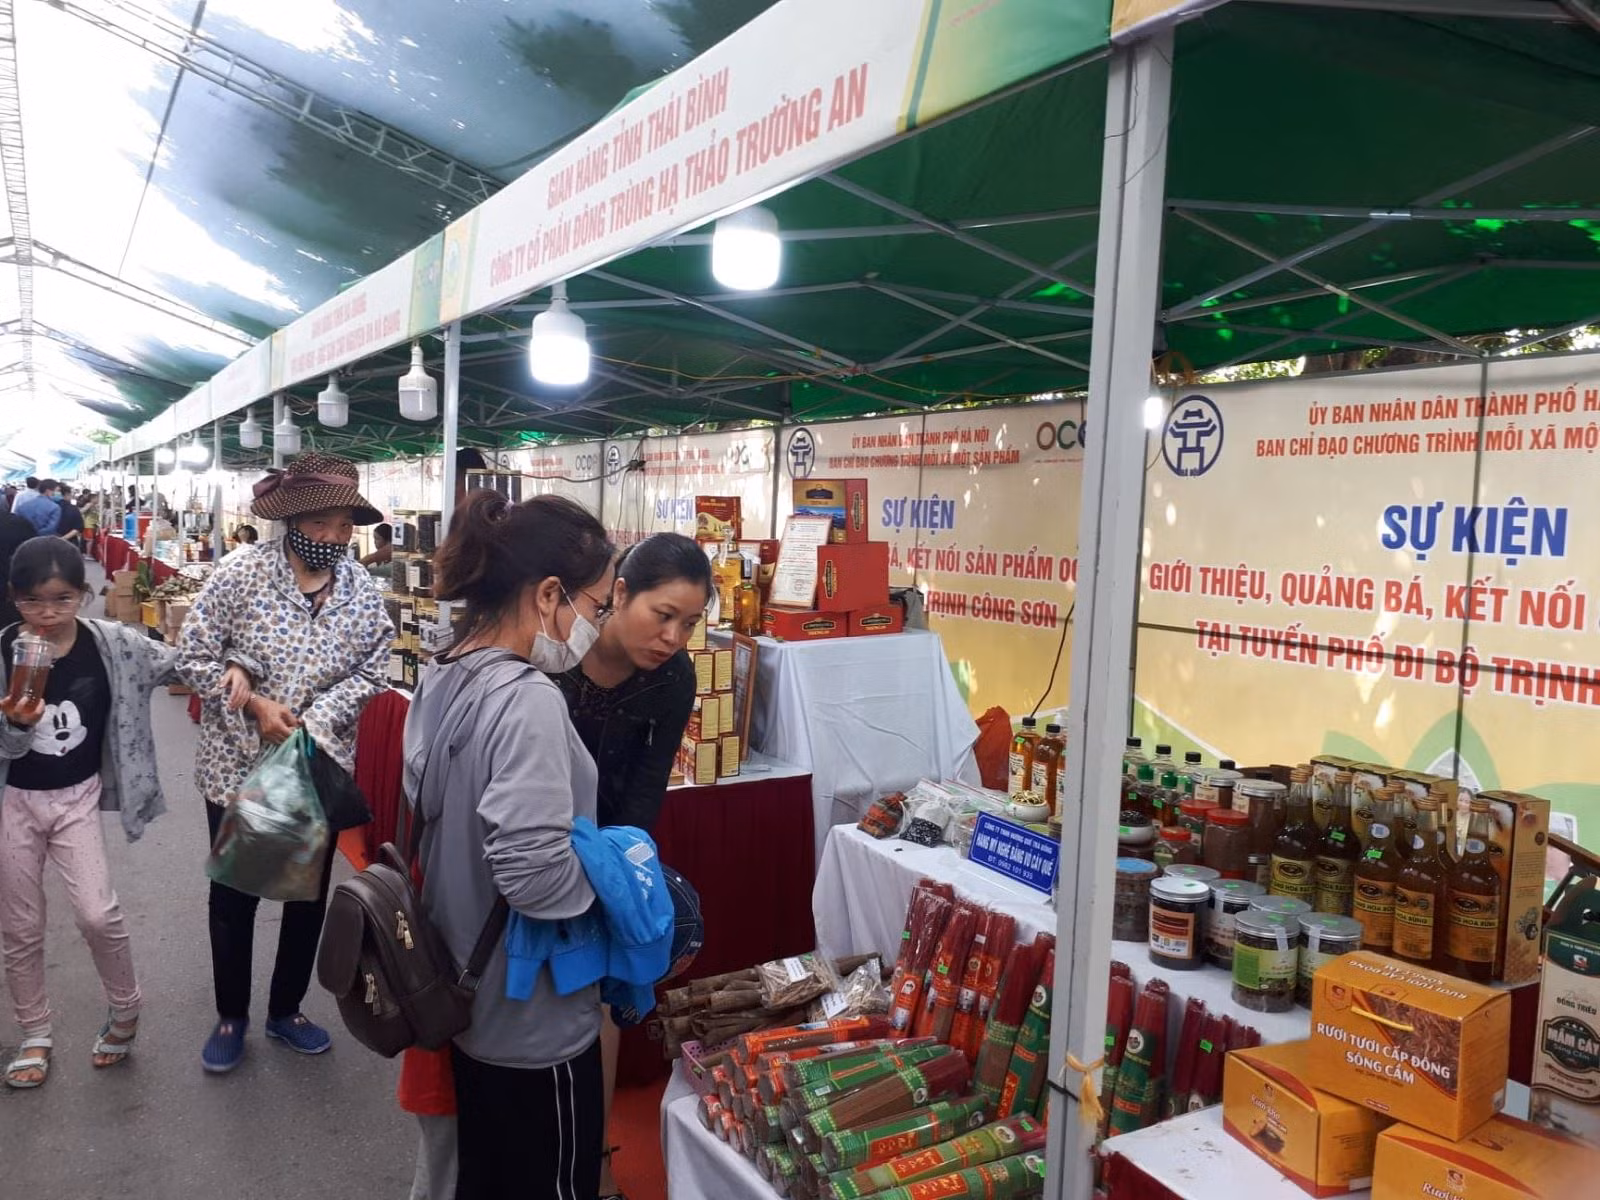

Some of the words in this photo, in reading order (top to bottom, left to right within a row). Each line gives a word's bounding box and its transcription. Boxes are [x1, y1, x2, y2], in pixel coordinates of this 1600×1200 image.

[548, 164, 574, 210] GIAN
[576, 145, 608, 193] HÀNG
[613, 119, 642, 173] TỈNH
[647, 91, 680, 154] THÁI
[685, 67, 729, 134] BÌNH
[515, 244, 526, 276] TY
[610, 178, 654, 233] TRÙNG
[658, 164, 678, 215] HẠ
[685, 129, 729, 199] THẢO
[736, 88, 821, 176] TRƯỜNG
[828, 63, 868, 132] AN
[1309, 401, 1328, 426] ỦY
[1332, 405, 1364, 424] BAN
[1369, 398, 1415, 422] NHÂN
[1421, 395, 1459, 420] DÂN
[1464, 392, 1528, 417] THÀNH
[1534, 382, 1578, 414] PHỐ
[1584, 390, 1600, 411] H
[862, 436, 876, 448] BAN
[878, 432, 897, 448] NHÂN
[916, 430, 940, 445] THÀNH
[961, 426, 972, 443] HÀ
[974, 426, 989, 446] NỘI
[1257, 440, 1284, 456] BAN
[1290, 432, 1313, 456] CHỈ
[1318, 436, 1348, 459] ĐẠO
[1354, 432, 1420, 454] CHƯƠNG
[1425, 428, 1480, 452] TRÌNH
[1485, 422, 1523, 450] MỖI
[1529, 424, 1556, 450] XÃ
[1564, 422, 1600, 454] MỘ
[882, 498, 907, 533] SỰ
[910, 494, 956, 535] KIỆN
[1382, 501, 1444, 560] SỰ
[1451, 496, 1568, 566] KIỆN
[888, 547, 902, 570] Á,
[908, 541, 932, 568] KẾT
[936, 542, 960, 572] NỐI
[965, 545, 998, 576] SẢN
[1002, 546, 1052, 580] PHẨM
[926, 590, 966, 618] TRỊNH
[972, 593, 1014, 622] CÔNG
[1021, 600, 1056, 628] SƠN
[1150, 558, 1191, 592] GIỚI
[1200, 564, 1272, 604] THIỆU,
[1281, 566, 1374, 610] QUẢNG
[1384, 576, 1433, 620] BÁ,
[1446, 576, 1509, 622] KẾT
[1519, 580, 1586, 630] NỐI
[1196, 620, 1230, 656] TẠI
[1239, 623, 1318, 664] TUYẾN
[1328, 632, 1385, 672] PHỐ
[1394, 645, 1424, 680] ĐI
[1435, 646, 1480, 694] BỘ
[1492, 656, 1600, 705] TRỊNH
[1317, 1022, 1346, 1042] RƯƠI
[1350, 1034, 1380, 1054] TƯƠI
[1383, 1046, 1408, 1062] CẤP
[1411, 1056, 1450, 1078] ĐÔNG
[1346, 1052, 1382, 1072] SÔNG
